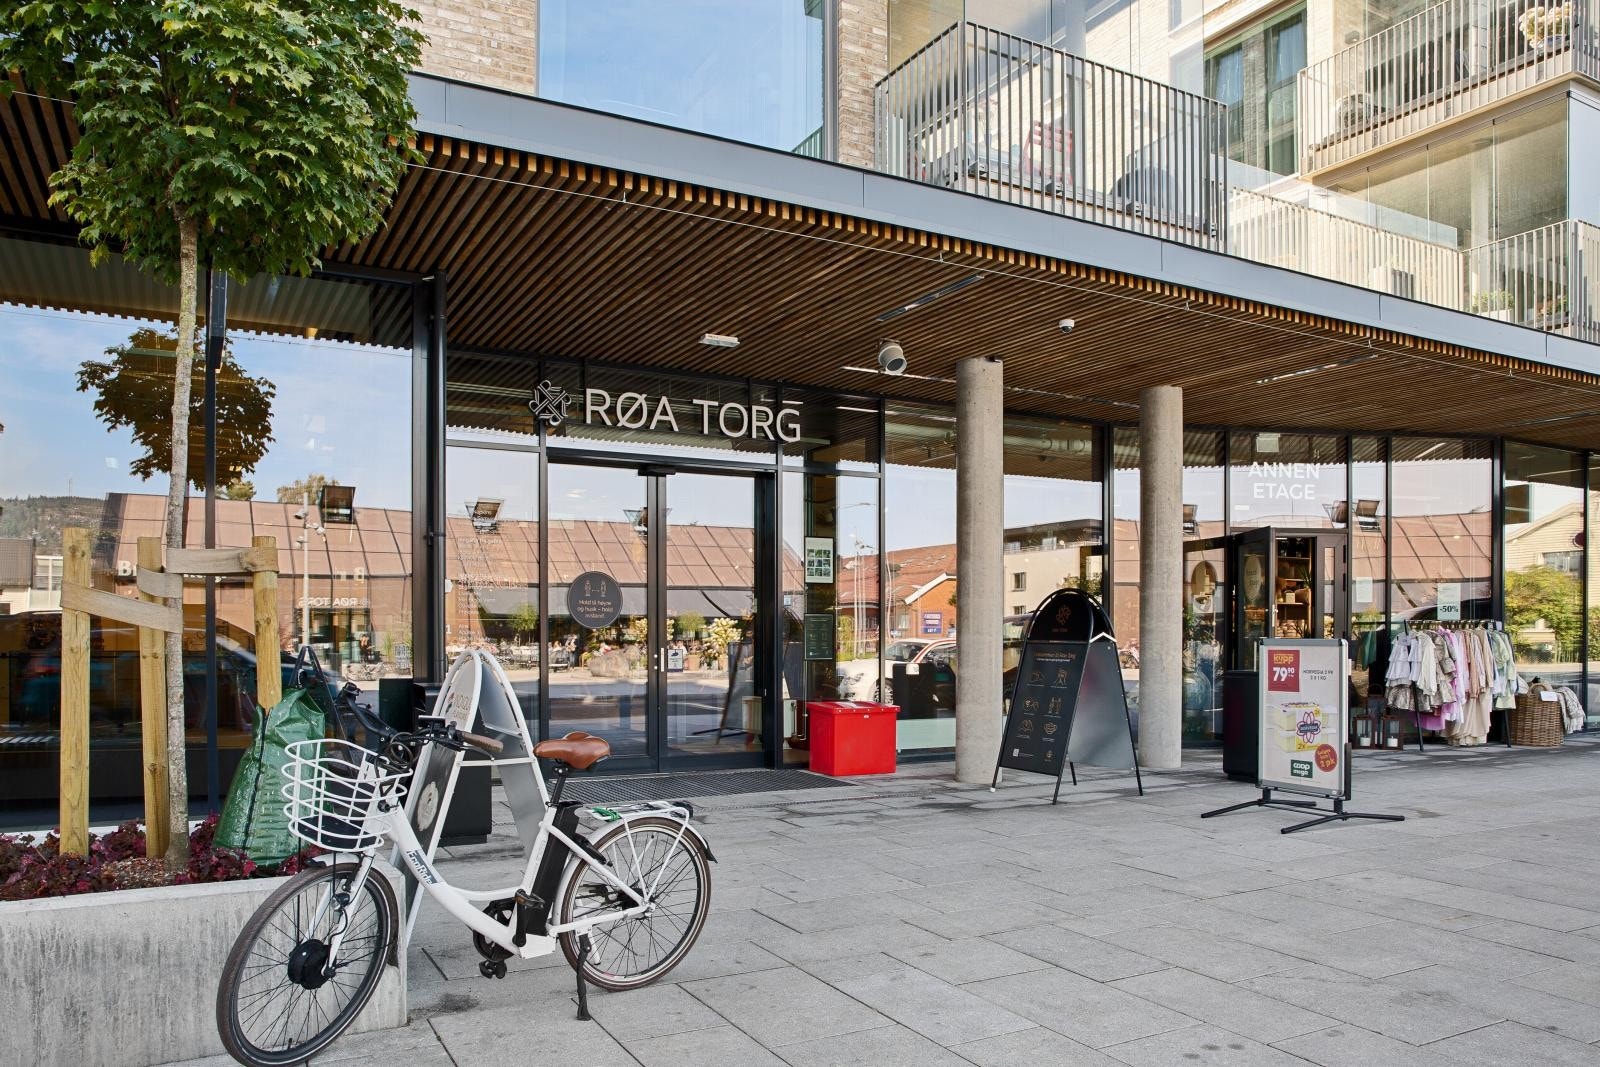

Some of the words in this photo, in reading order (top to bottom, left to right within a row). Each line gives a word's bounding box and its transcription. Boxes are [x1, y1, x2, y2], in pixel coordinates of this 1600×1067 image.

[585, 387, 679, 432] RØA
[692, 398, 804, 443] TORG
[1249, 461, 1321, 480] ANNEN
[1253, 482, 1316, 500] ETAGE
[1439, 605, 1459, 613] -50%
[1293, 762, 1310, 770] coop
